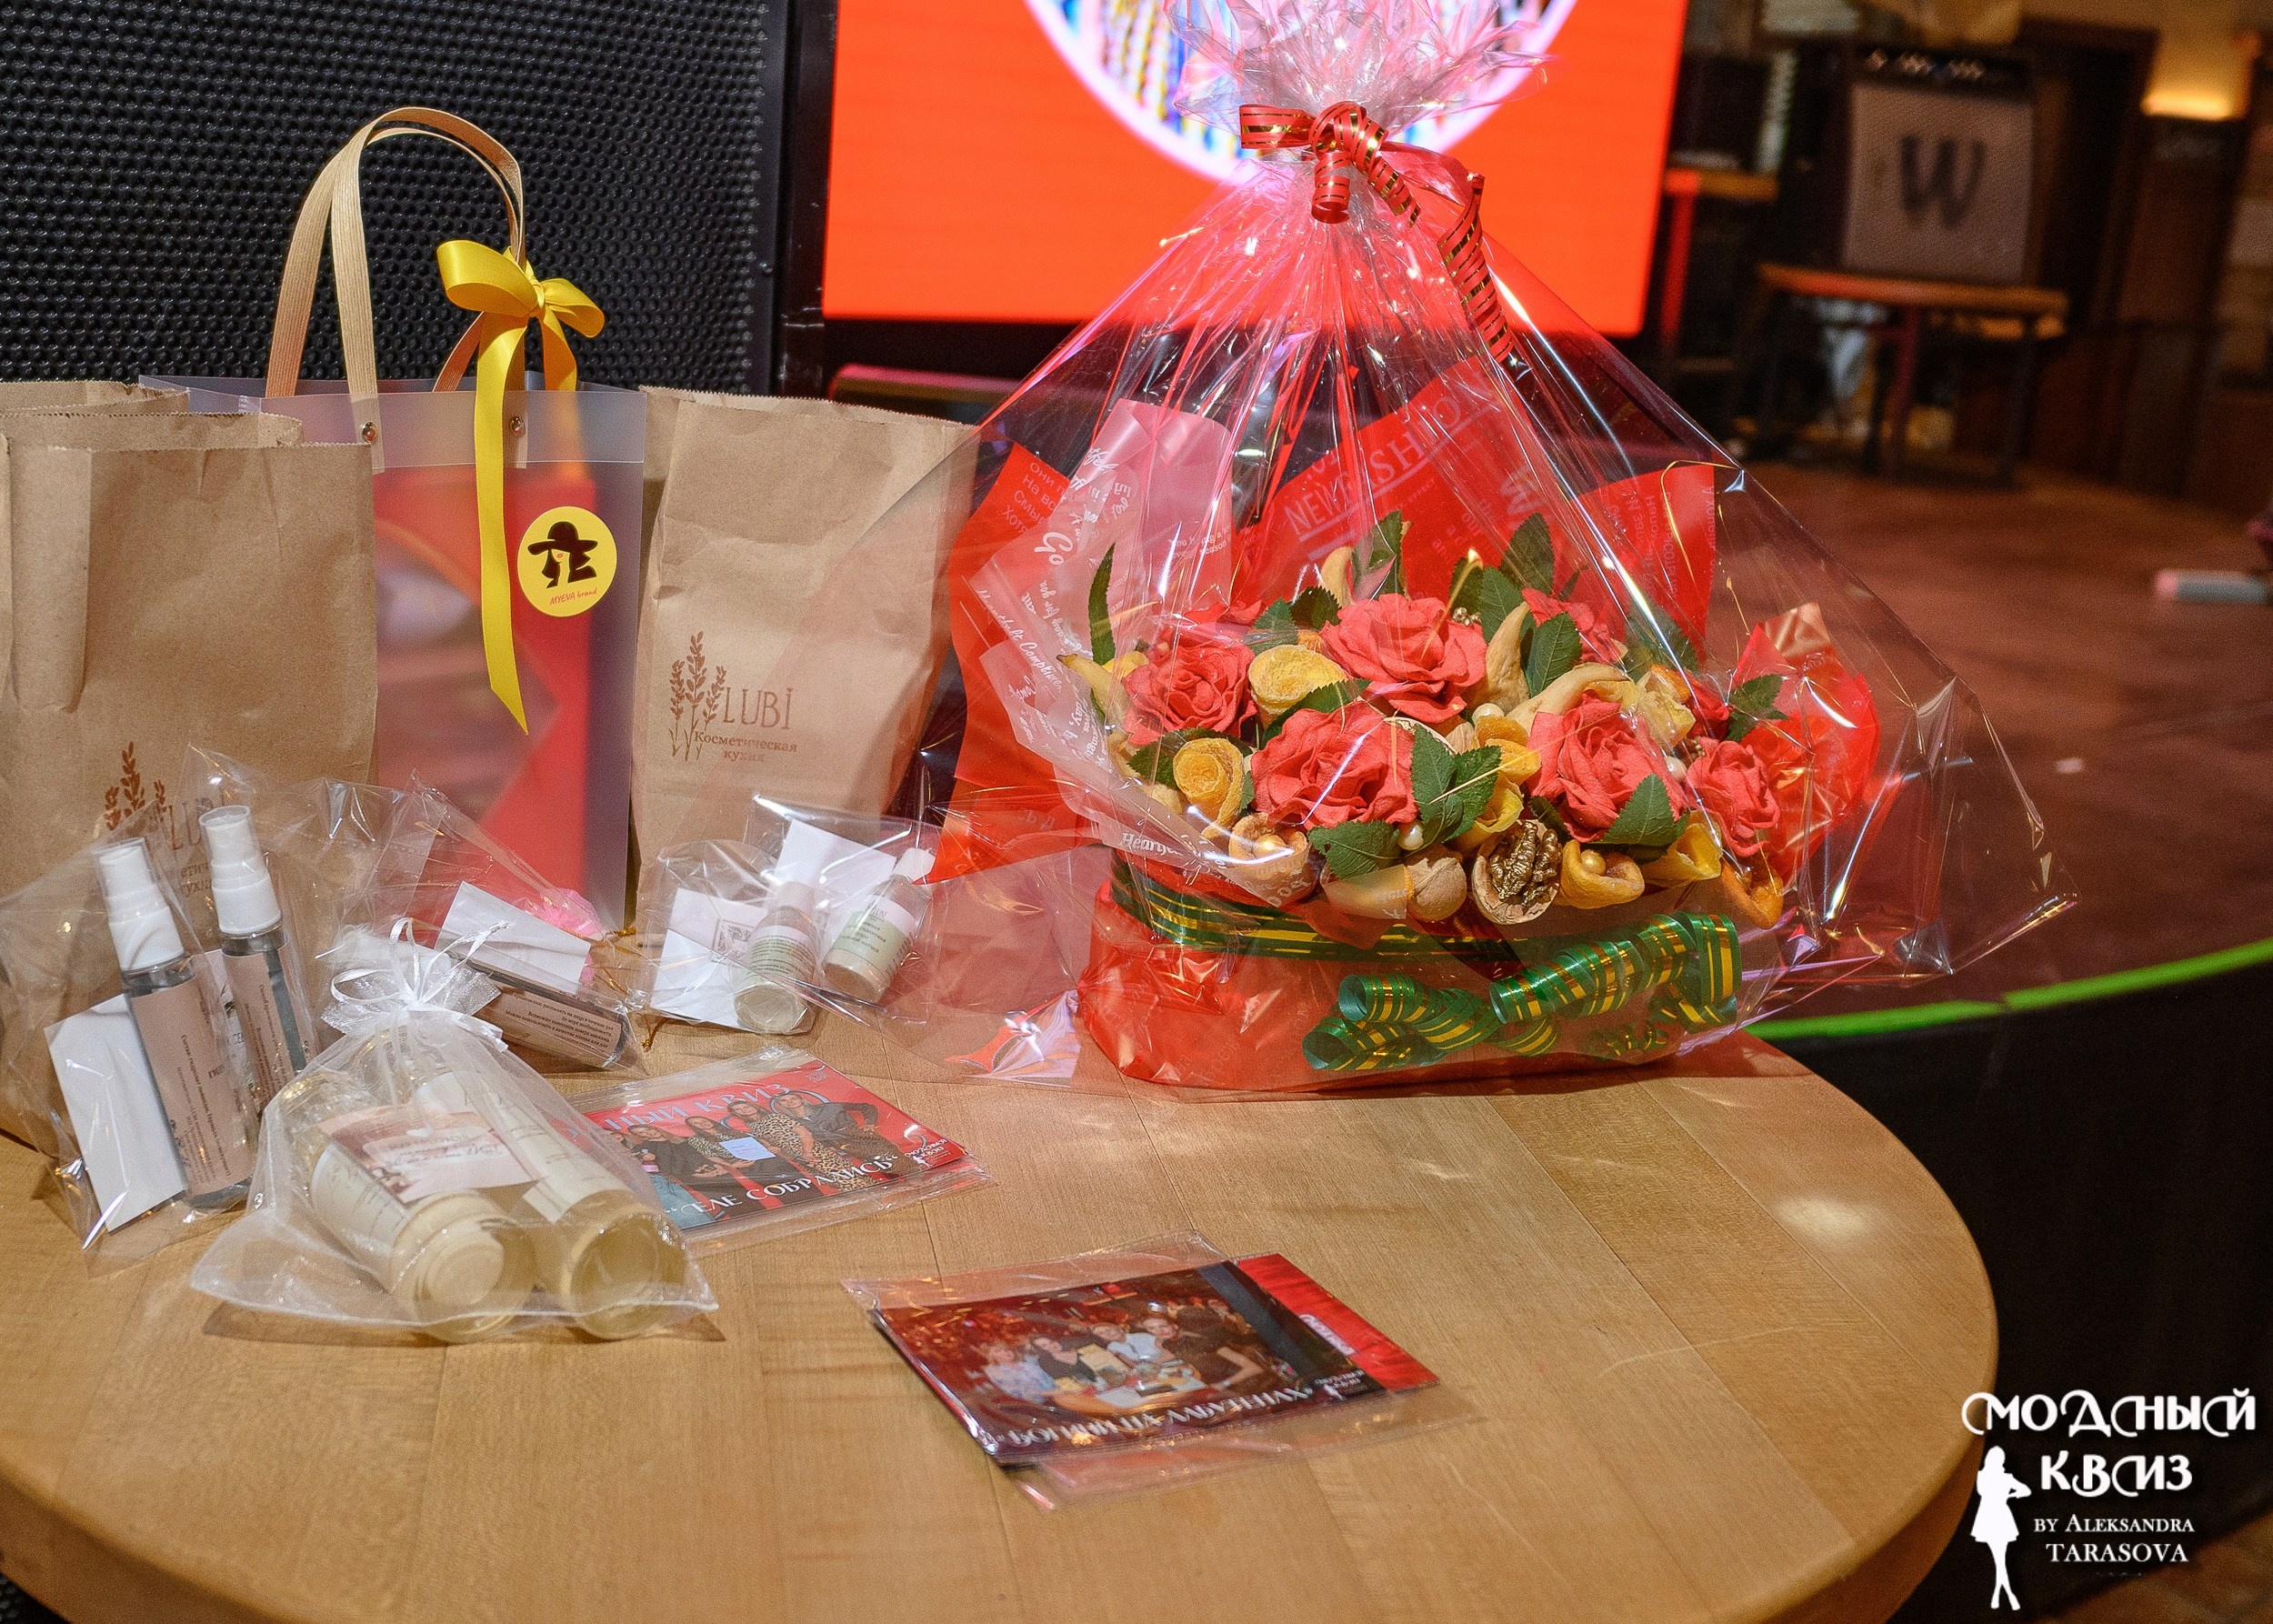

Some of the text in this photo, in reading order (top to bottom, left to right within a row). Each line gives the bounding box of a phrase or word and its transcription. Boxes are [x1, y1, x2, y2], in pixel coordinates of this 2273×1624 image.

[1034, 531, 1074, 566] Go
[694, 730, 797, 752] Косметическая
[694, 1083, 791, 1113] КВИЗ
